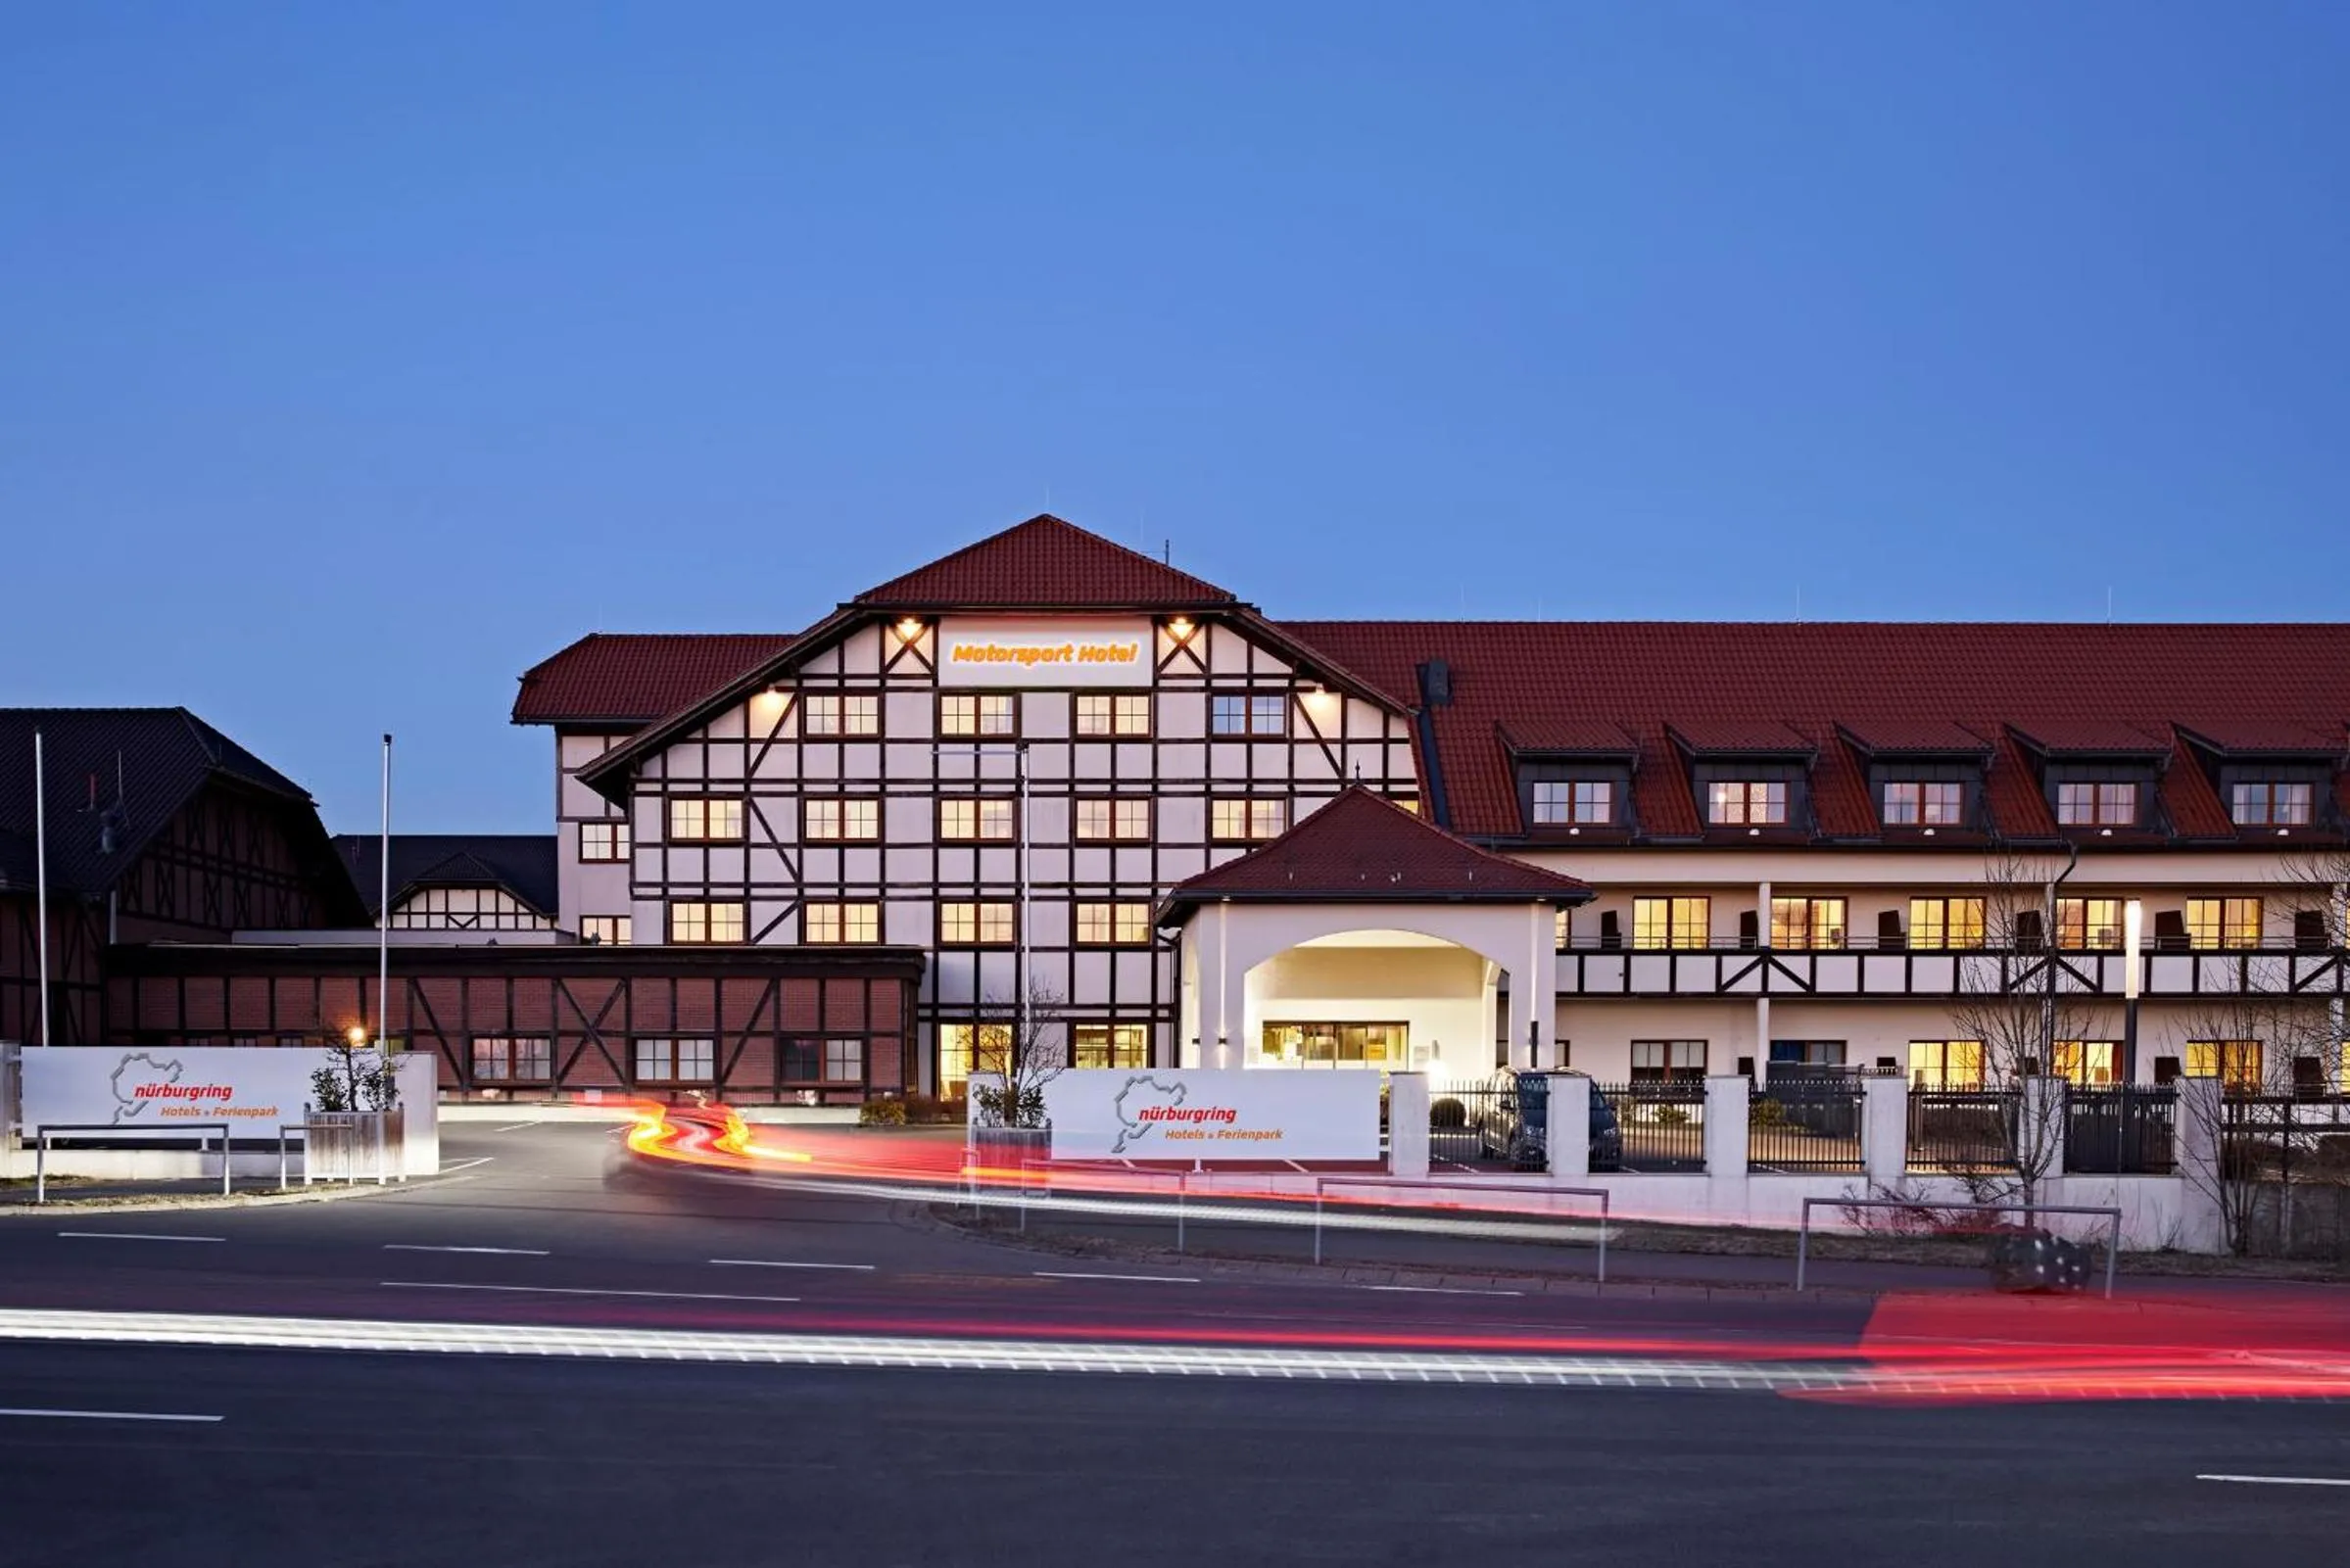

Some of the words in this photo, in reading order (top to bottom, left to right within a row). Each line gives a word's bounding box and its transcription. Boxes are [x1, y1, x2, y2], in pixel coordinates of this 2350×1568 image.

[953, 642, 1075, 666] Motorsport
[1079, 642, 1138, 663] Hotel
[135, 1083, 233, 1101] nürburgring
[161, 1107, 201, 1117] Hotels
[213, 1106, 278, 1118] Ferienpark
[1138, 1106, 1236, 1123] nürburgring
[1165, 1129, 1204, 1140] Hotels
[1217, 1128, 1283, 1142] Ferienpark
